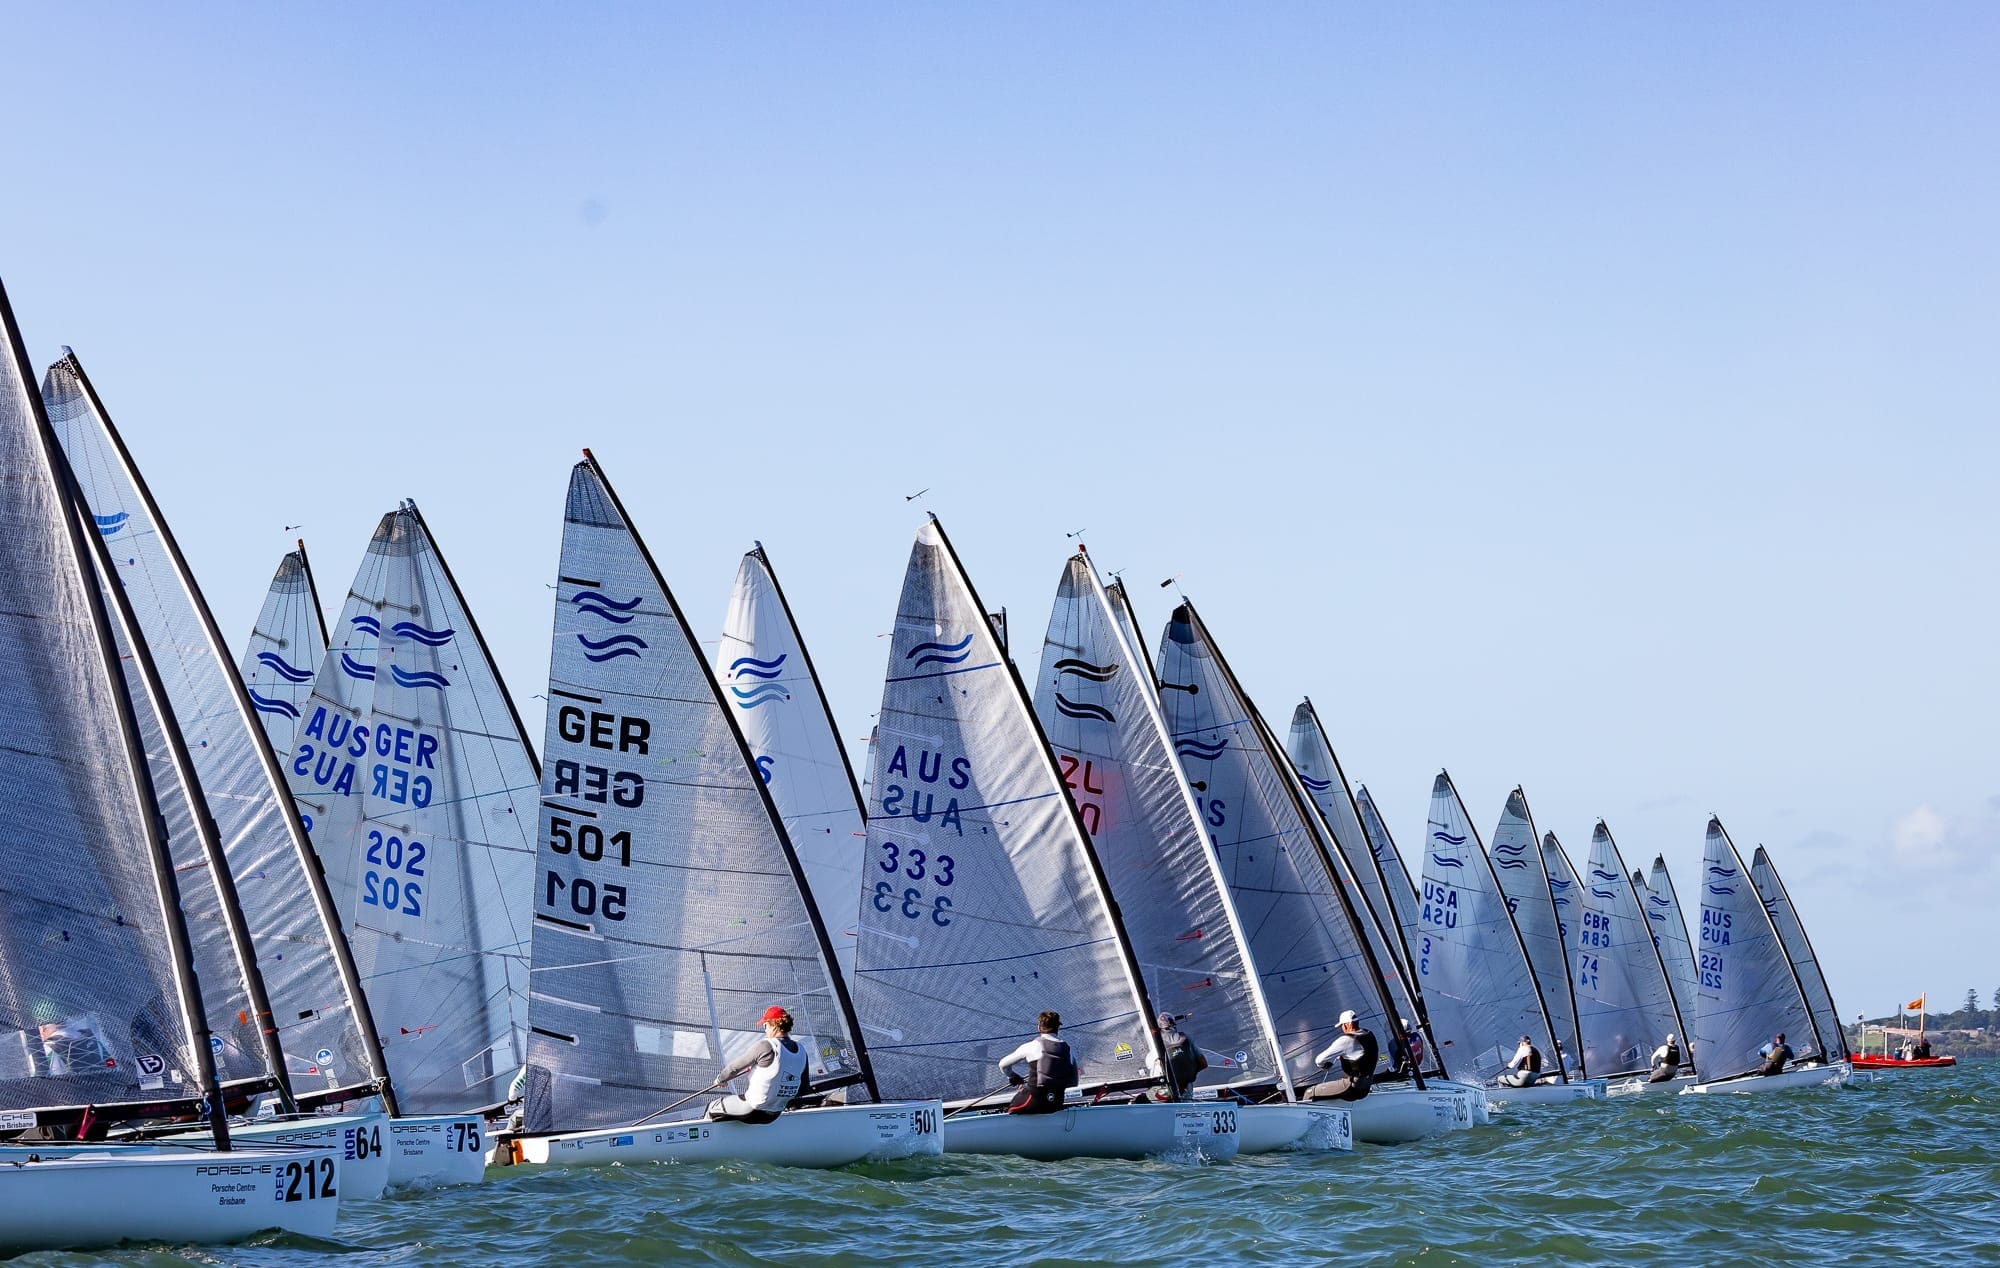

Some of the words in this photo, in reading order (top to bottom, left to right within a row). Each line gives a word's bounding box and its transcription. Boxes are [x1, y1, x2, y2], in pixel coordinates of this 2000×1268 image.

[305, 706, 370, 758] AUS
[559, 705, 651, 755] GER
[375, 723, 438, 769] GER
[887, 745, 971, 789] AUS
[1061, 754, 1104, 795] ZL
[366, 830, 426, 877] 202
[550, 816, 632, 868] 501
[879, 841, 955, 887] 333
[1424, 882, 1457, 909] USA
[1583, 911, 1610, 932] GBR
[1703, 909, 1732, 928] AUS
[1422, 937, 1431, 955] 3
[1582, 955, 1598, 973] 74
[1701, 954, 1723, 973] 221
[6, 1121, 34, 1129] Brisbane
[869, 1112, 906, 1120] PORSCHE
[915, 1108, 937, 1136] 501
[1213, 1110, 1236, 1134] 333
[1343, 1116, 1349, 1138] 9
[276, 1129, 337, 1143] PORSCHE
[345, 1128, 355, 1160] NOR
[356, 1125, 382, 1160] 64
[454, 1122, 480, 1152] 75
[196, 1164, 272, 1176] PORSCHE
[275, 1166, 284, 1201] DEN
[285, 1157, 336, 1203] 212
[211, 1183, 235, 1193] Porsche
[236, 1183, 256, 1192] Centre
[219, 1197, 246, 1206] Brisbane
